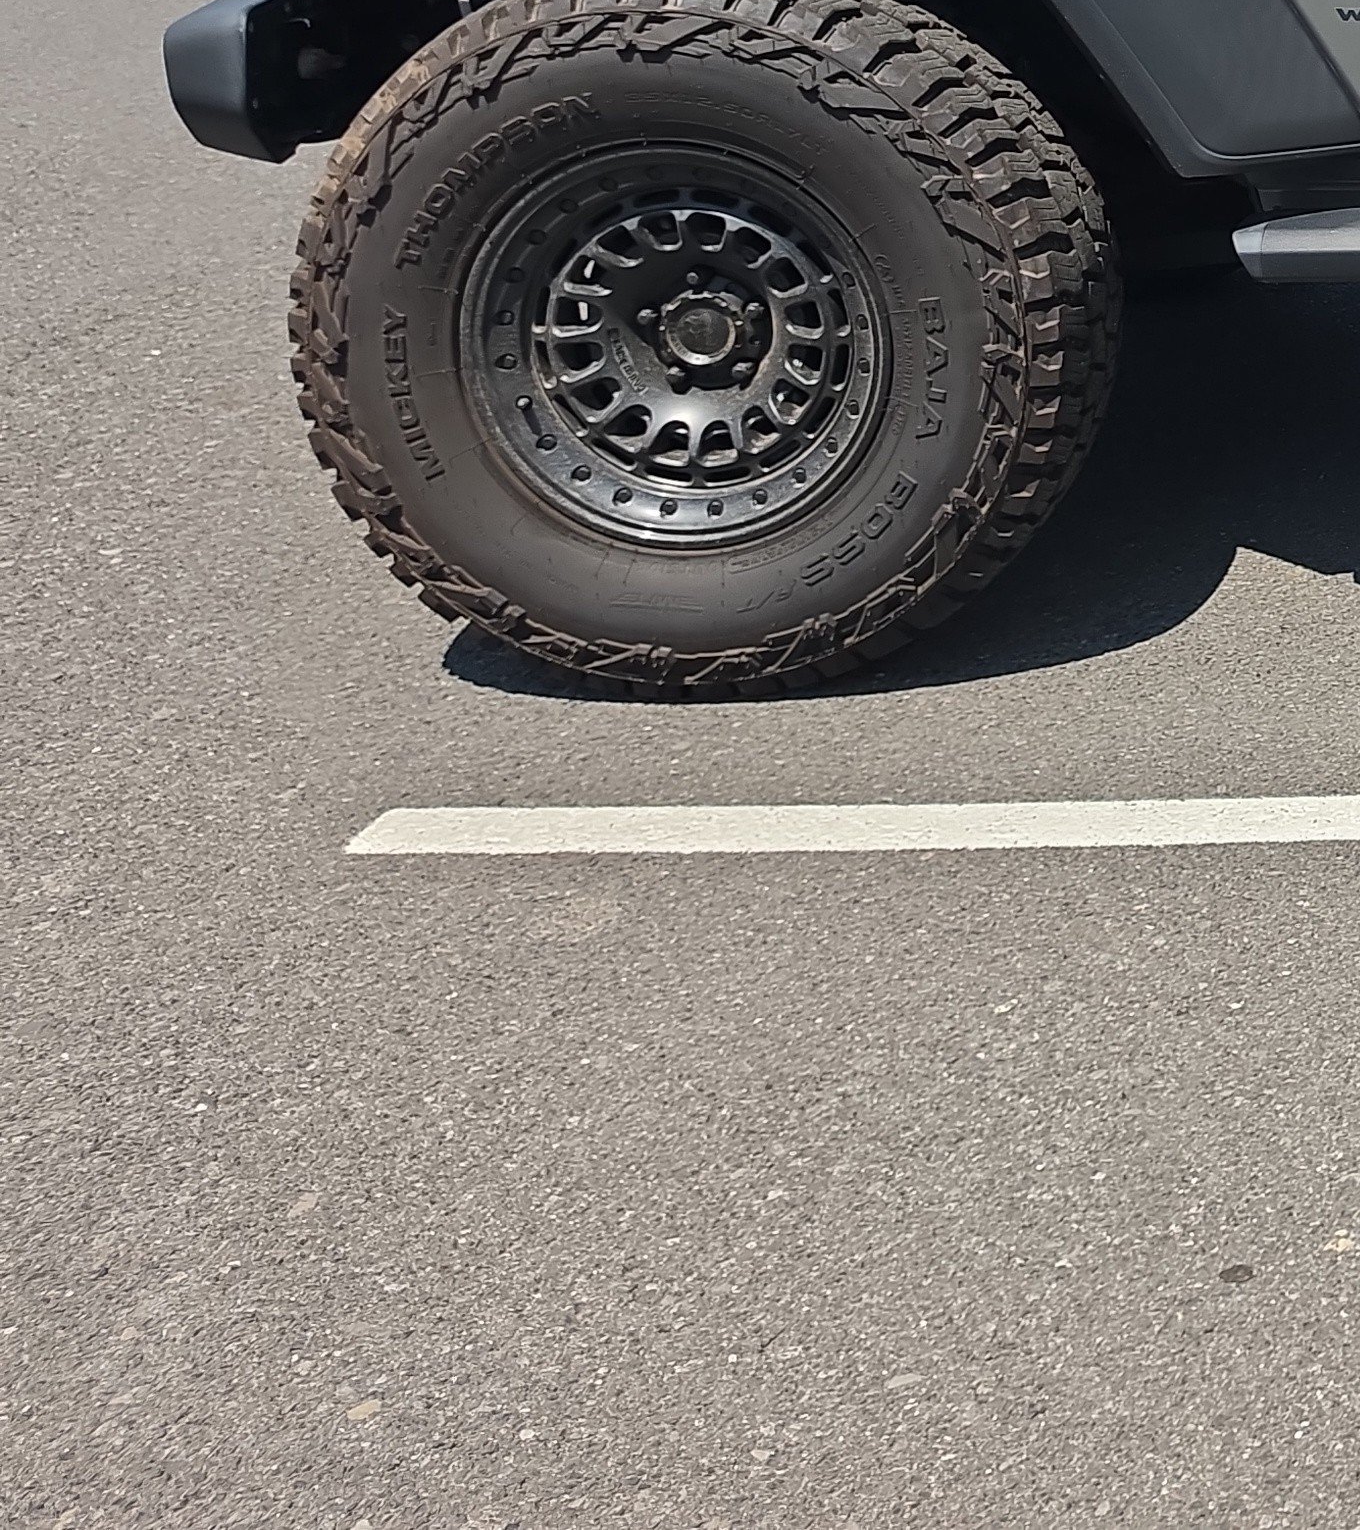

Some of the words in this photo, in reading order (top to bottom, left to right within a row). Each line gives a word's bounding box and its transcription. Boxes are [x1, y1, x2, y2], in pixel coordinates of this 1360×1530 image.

[394, 91, 599, 270] THOMPSON
[383, 303, 446, 482] MICKEY
[917, 296, 949, 439] BAJA
[800, 471, 918, 587] BOSS
